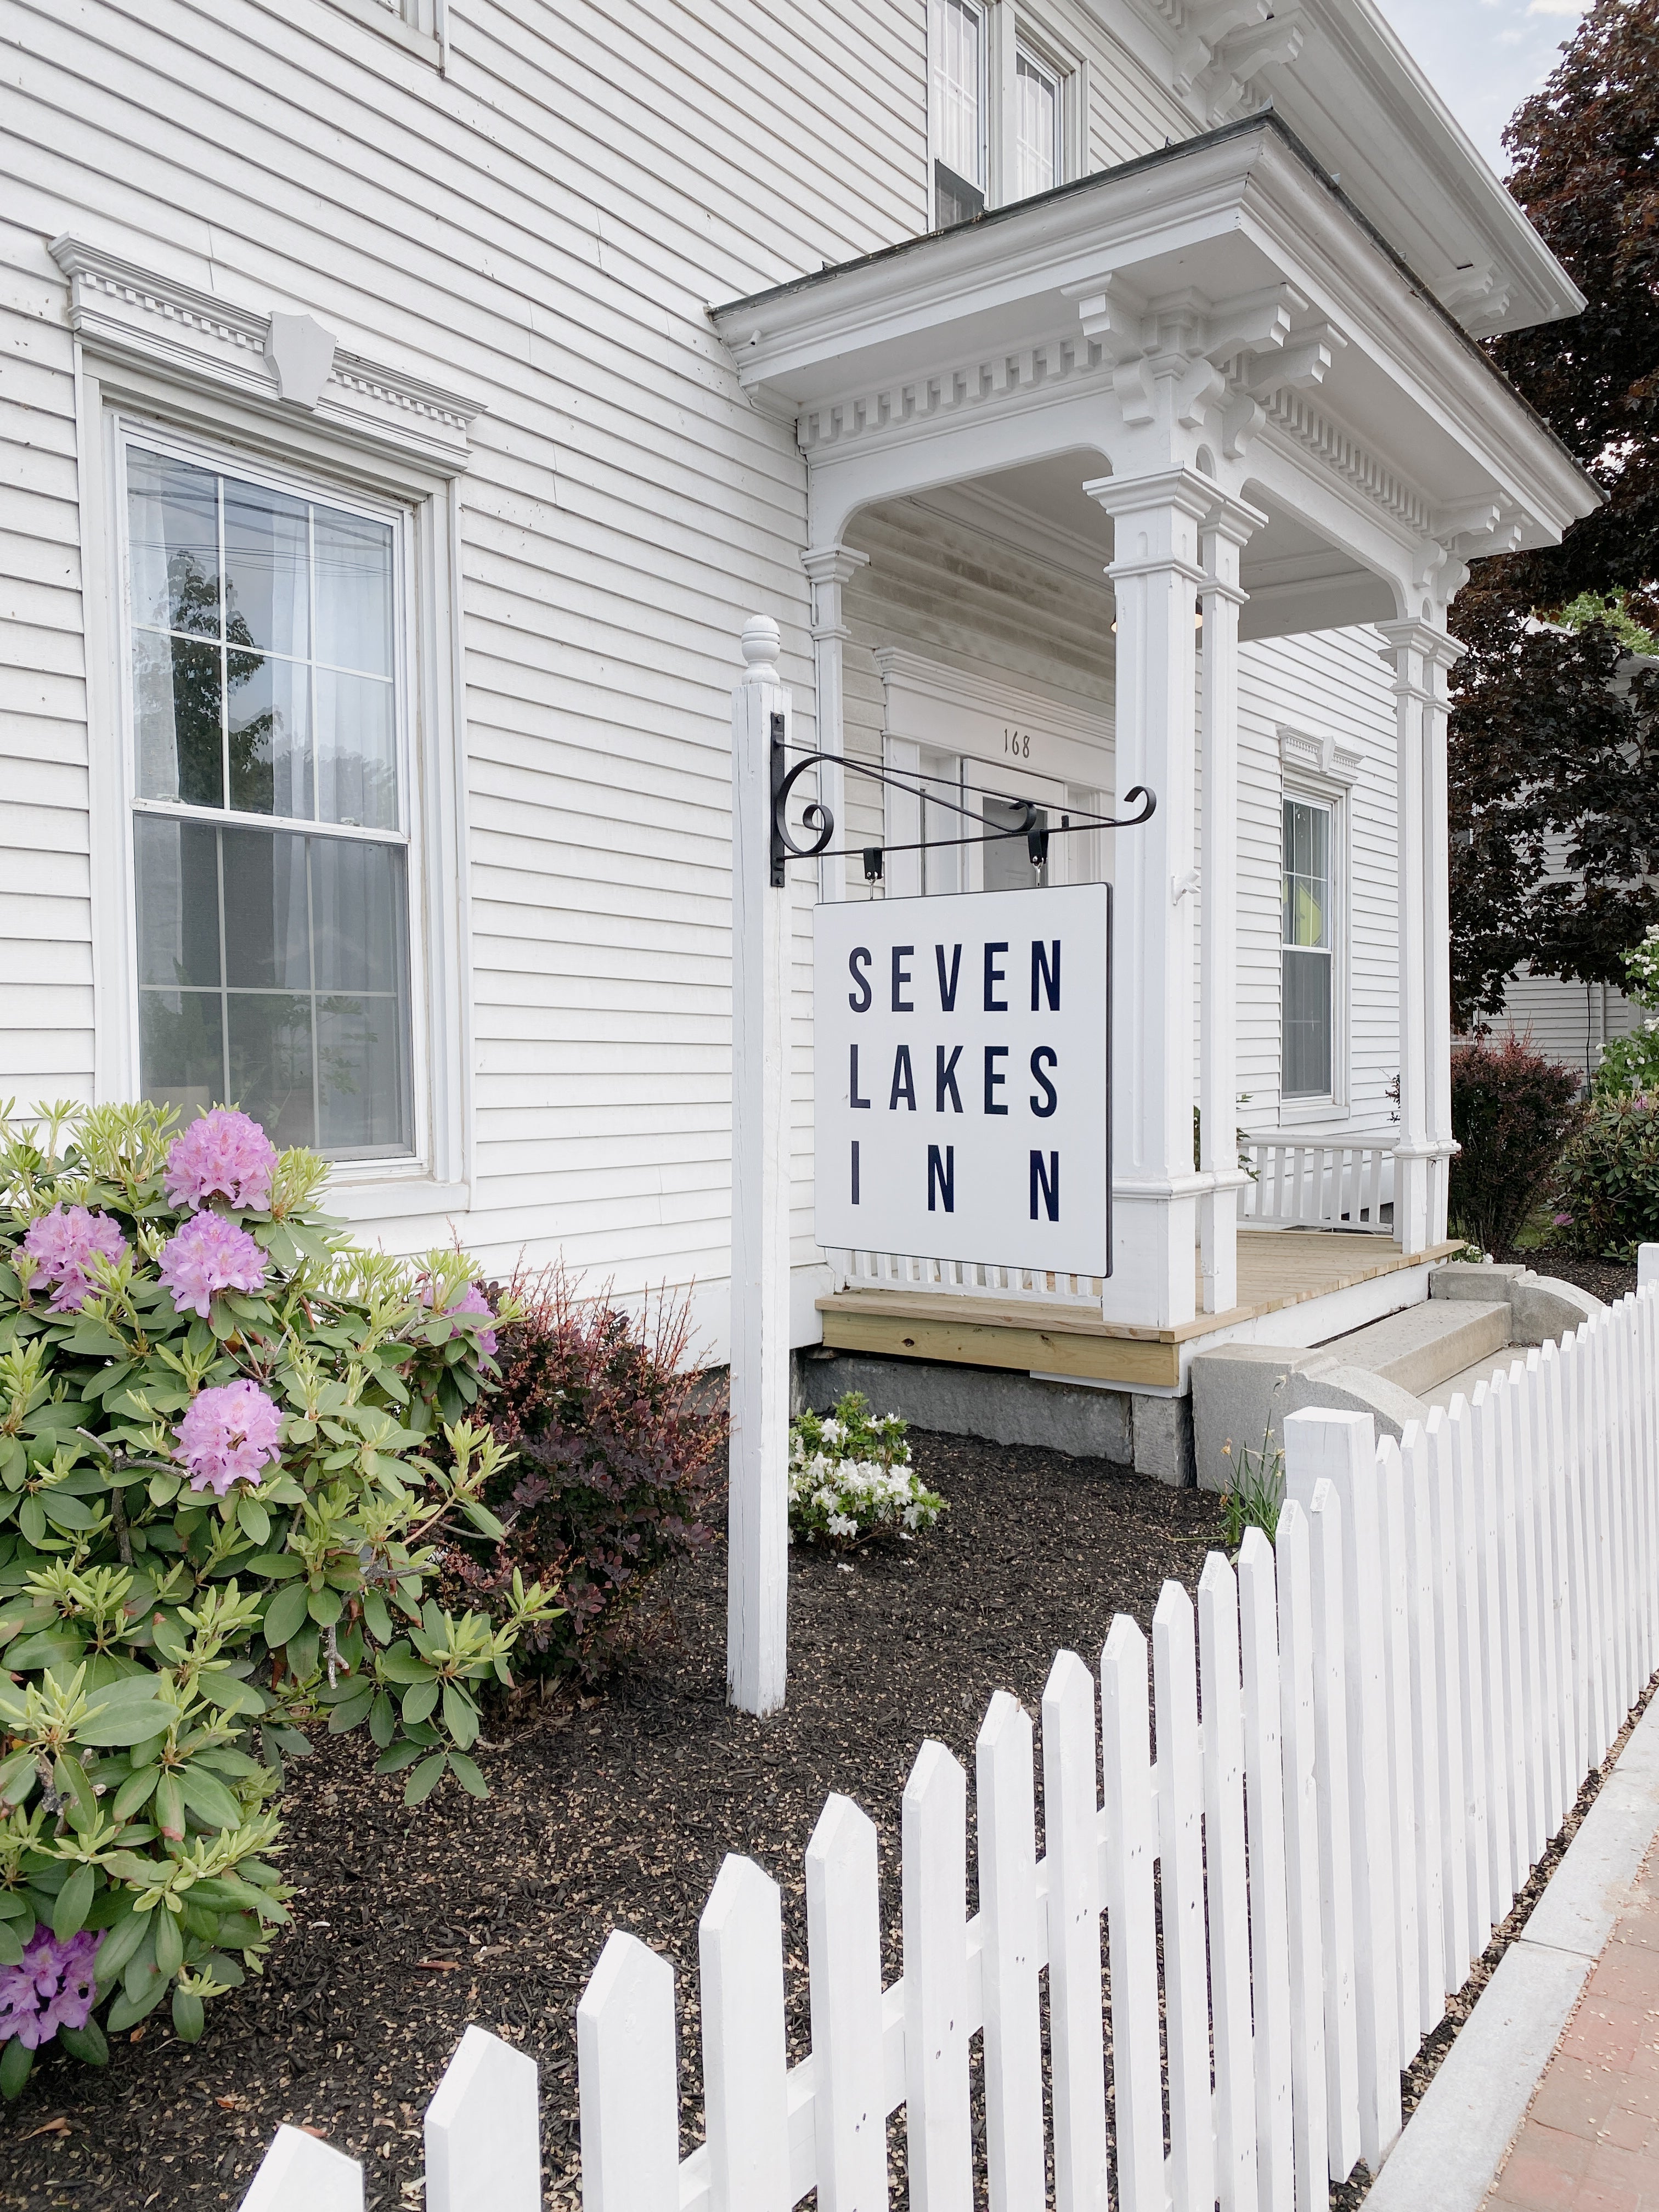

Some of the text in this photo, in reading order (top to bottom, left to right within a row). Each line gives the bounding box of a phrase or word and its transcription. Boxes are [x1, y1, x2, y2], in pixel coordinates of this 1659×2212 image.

[1005, 728, 1030, 759] 168
[848, 939, 1061, 1013] SEVEN
[849, 1044, 1058, 1118] LAKES
[851, 1140, 1059, 1222] INN
